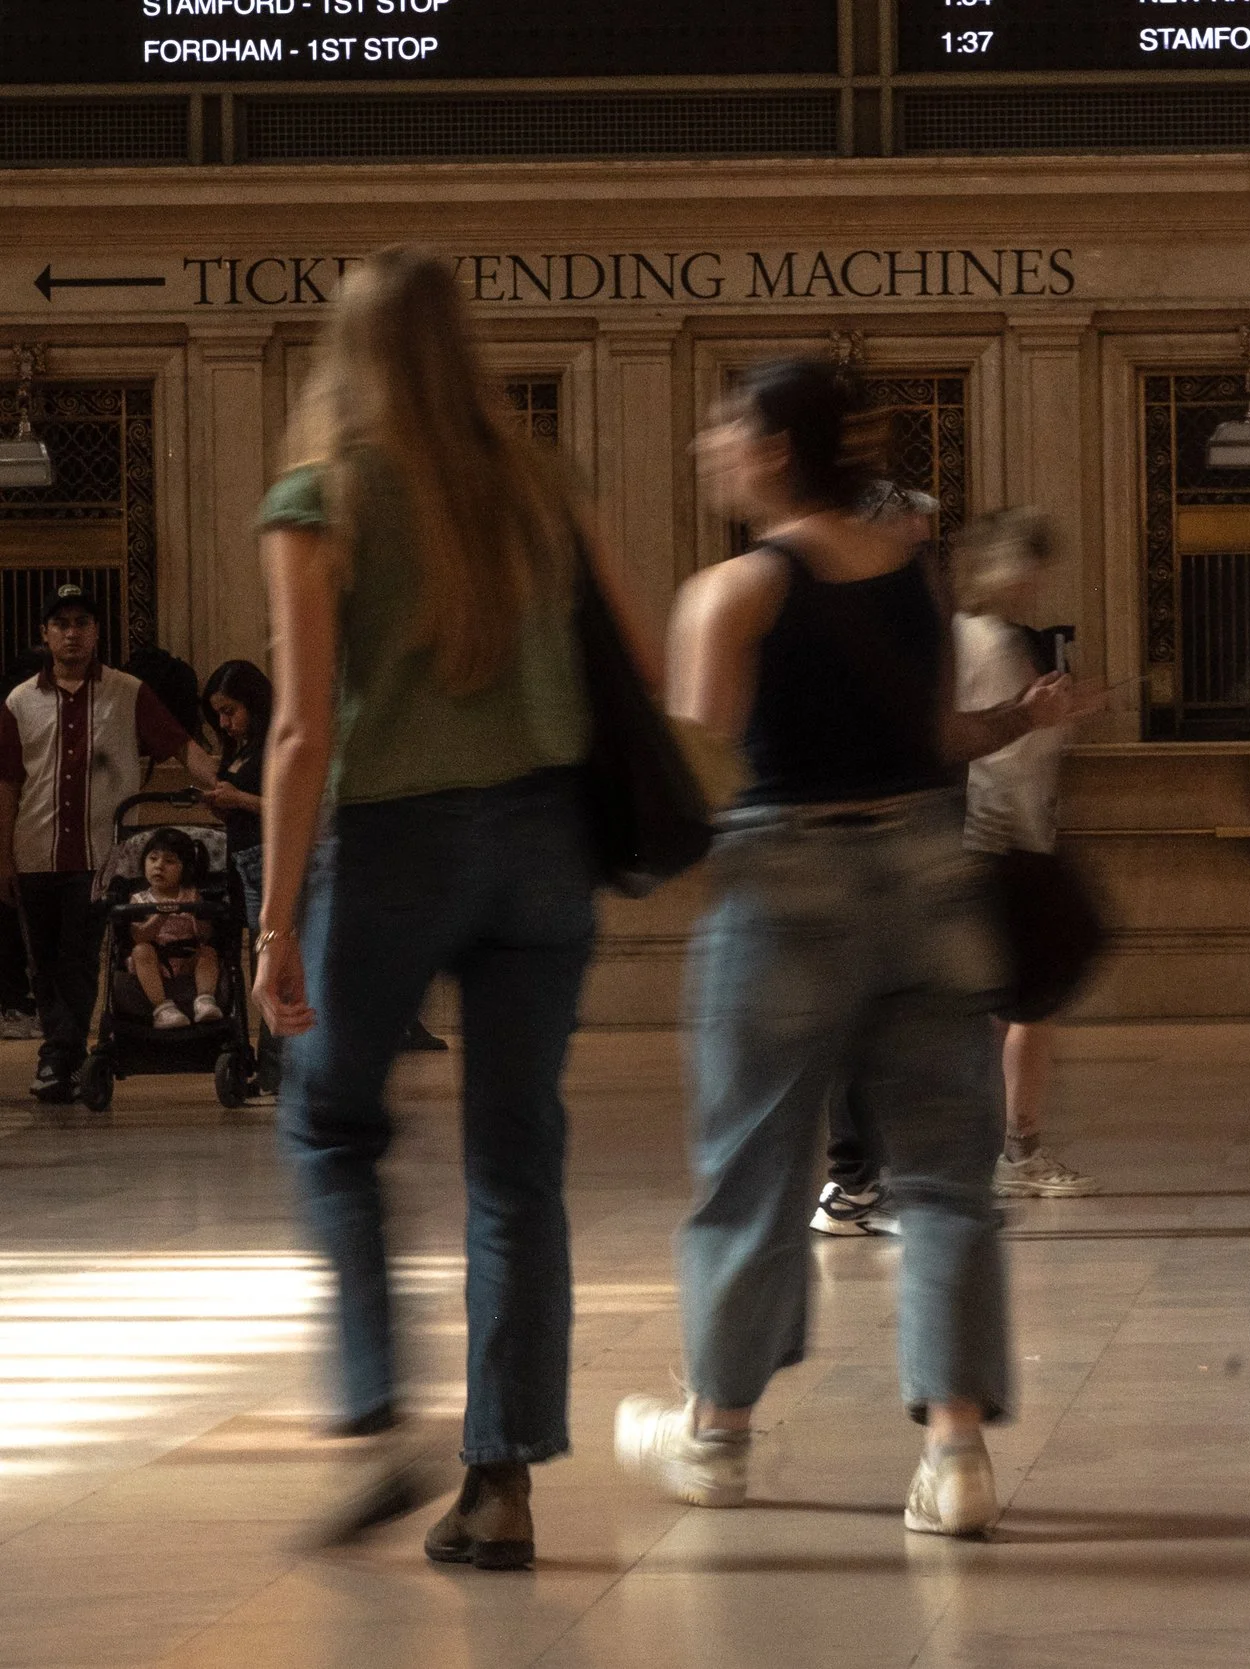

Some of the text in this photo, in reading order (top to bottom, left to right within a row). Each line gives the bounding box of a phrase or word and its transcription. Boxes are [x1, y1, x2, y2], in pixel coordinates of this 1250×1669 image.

[142, 0, 295, 17] STAMFORD
[143, 38, 282, 63] FORDHAM
[307, 37, 357, 62] 1ST
[363, 36, 439, 61] STOP
[941, 30, 994, 54] 1:37
[745, 247, 1076, 298] MACHINES
